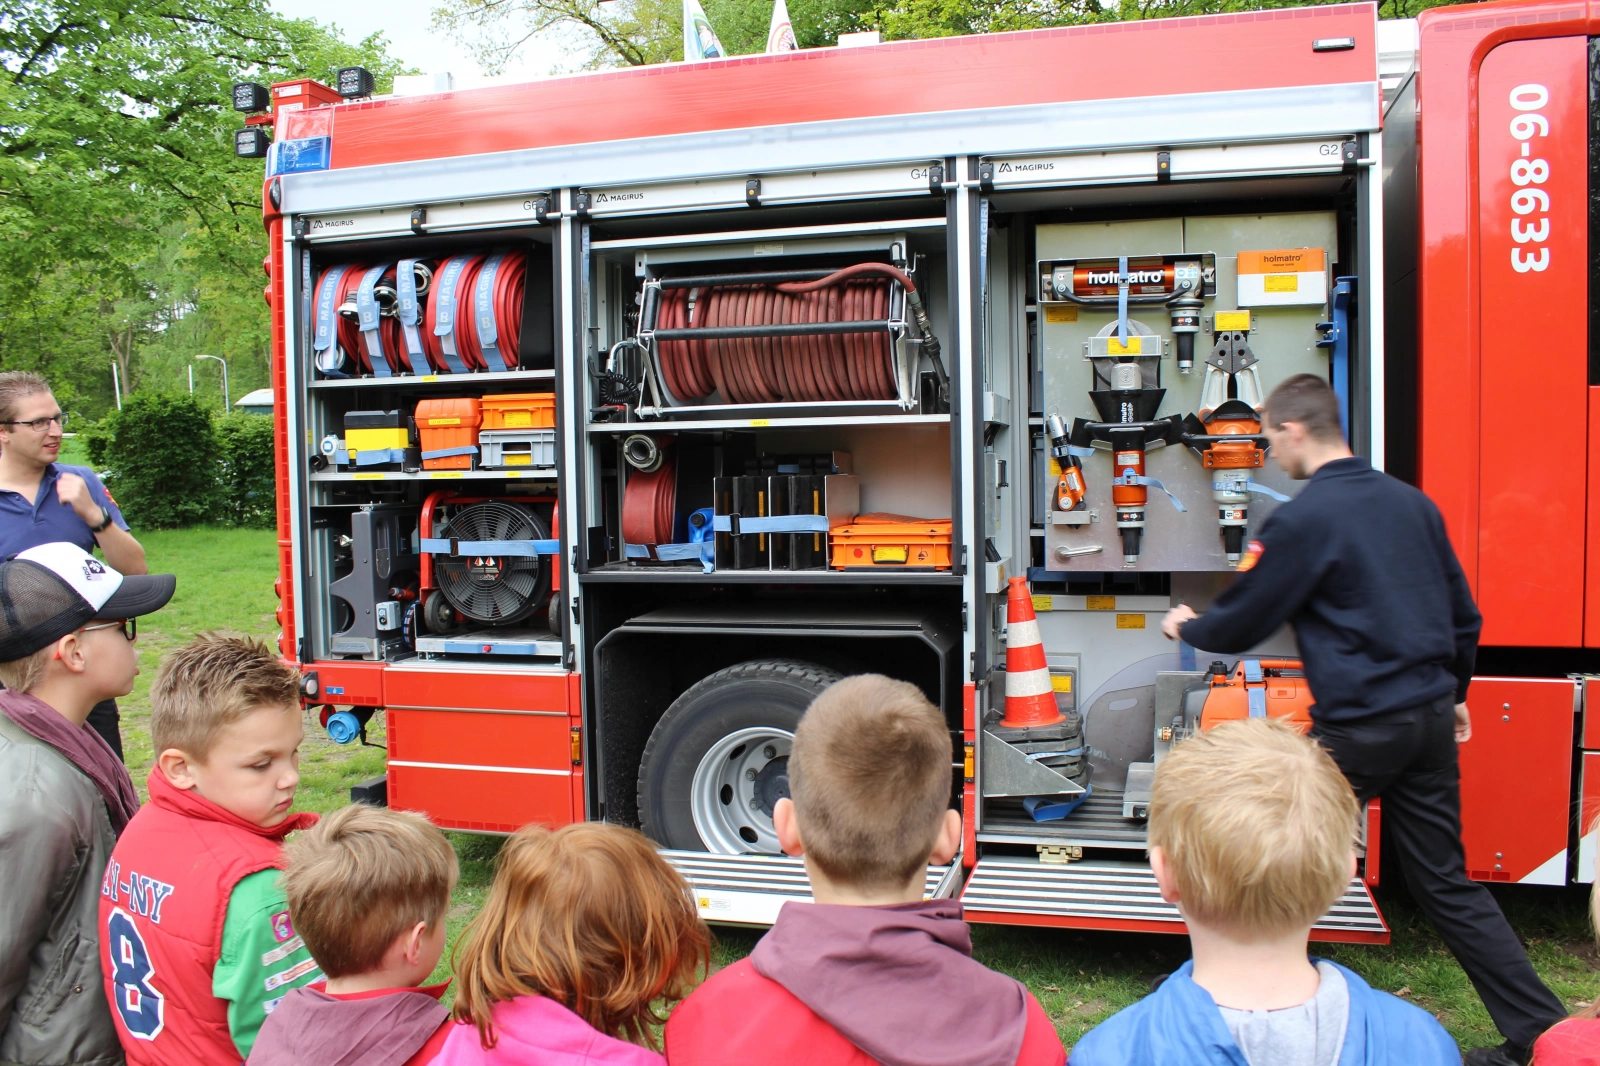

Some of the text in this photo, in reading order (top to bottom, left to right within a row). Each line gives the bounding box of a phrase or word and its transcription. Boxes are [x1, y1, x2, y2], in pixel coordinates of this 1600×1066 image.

[1319, 144, 1339, 156] G2
[1015, 163, 1054, 172] MAGIRUS
[911, 169, 928, 180] G4
[1509, 83, 1550, 273] 06-8633
[610, 193, 644, 202] MAGIRUS
[325, 219, 354, 228] MAGIRUS
[1263, 254, 1301, 263] holmatro
[1088, 270, 1162, 285] holatro
[480, 261, 497, 311] MAGIRUS
[320, 269, 341, 321] MAGIRUS
[108, 907, 165, 1041] 8
